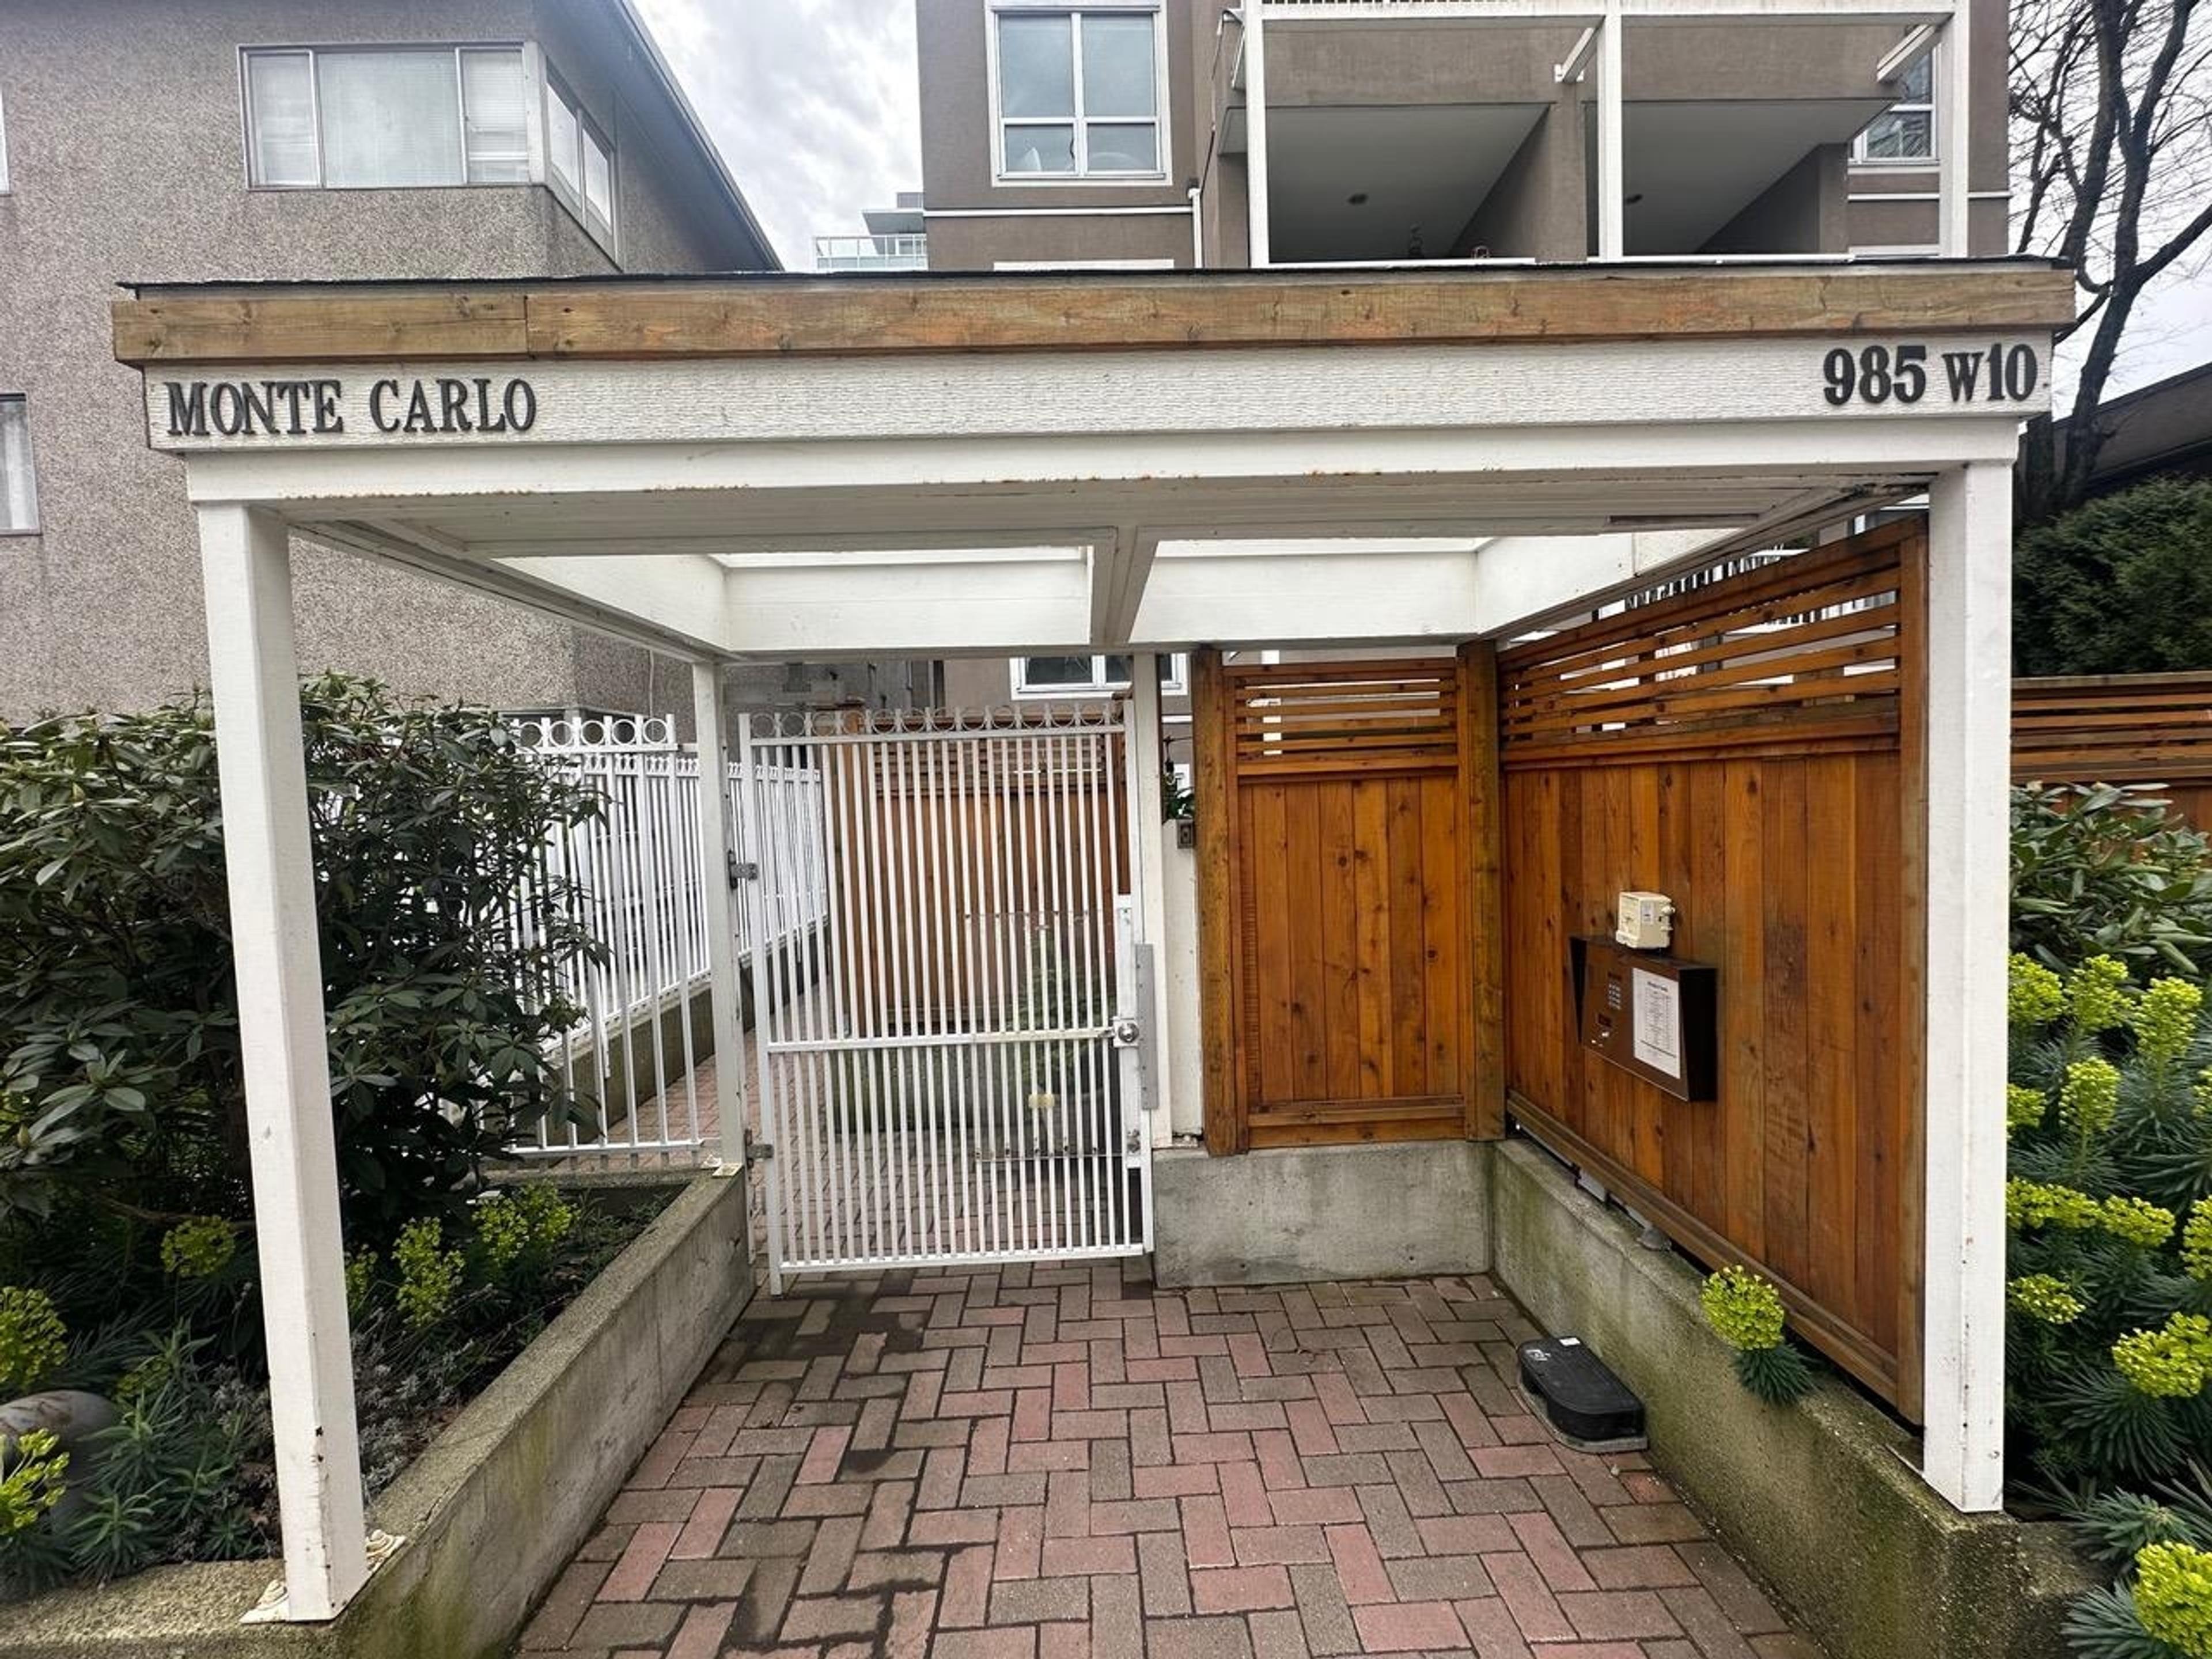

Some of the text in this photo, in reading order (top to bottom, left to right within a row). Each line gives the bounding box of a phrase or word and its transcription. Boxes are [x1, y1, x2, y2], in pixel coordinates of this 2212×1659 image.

[1823, 343, 2038, 406] 985 W10
[164, 378, 536, 436] MONTE CARLO
